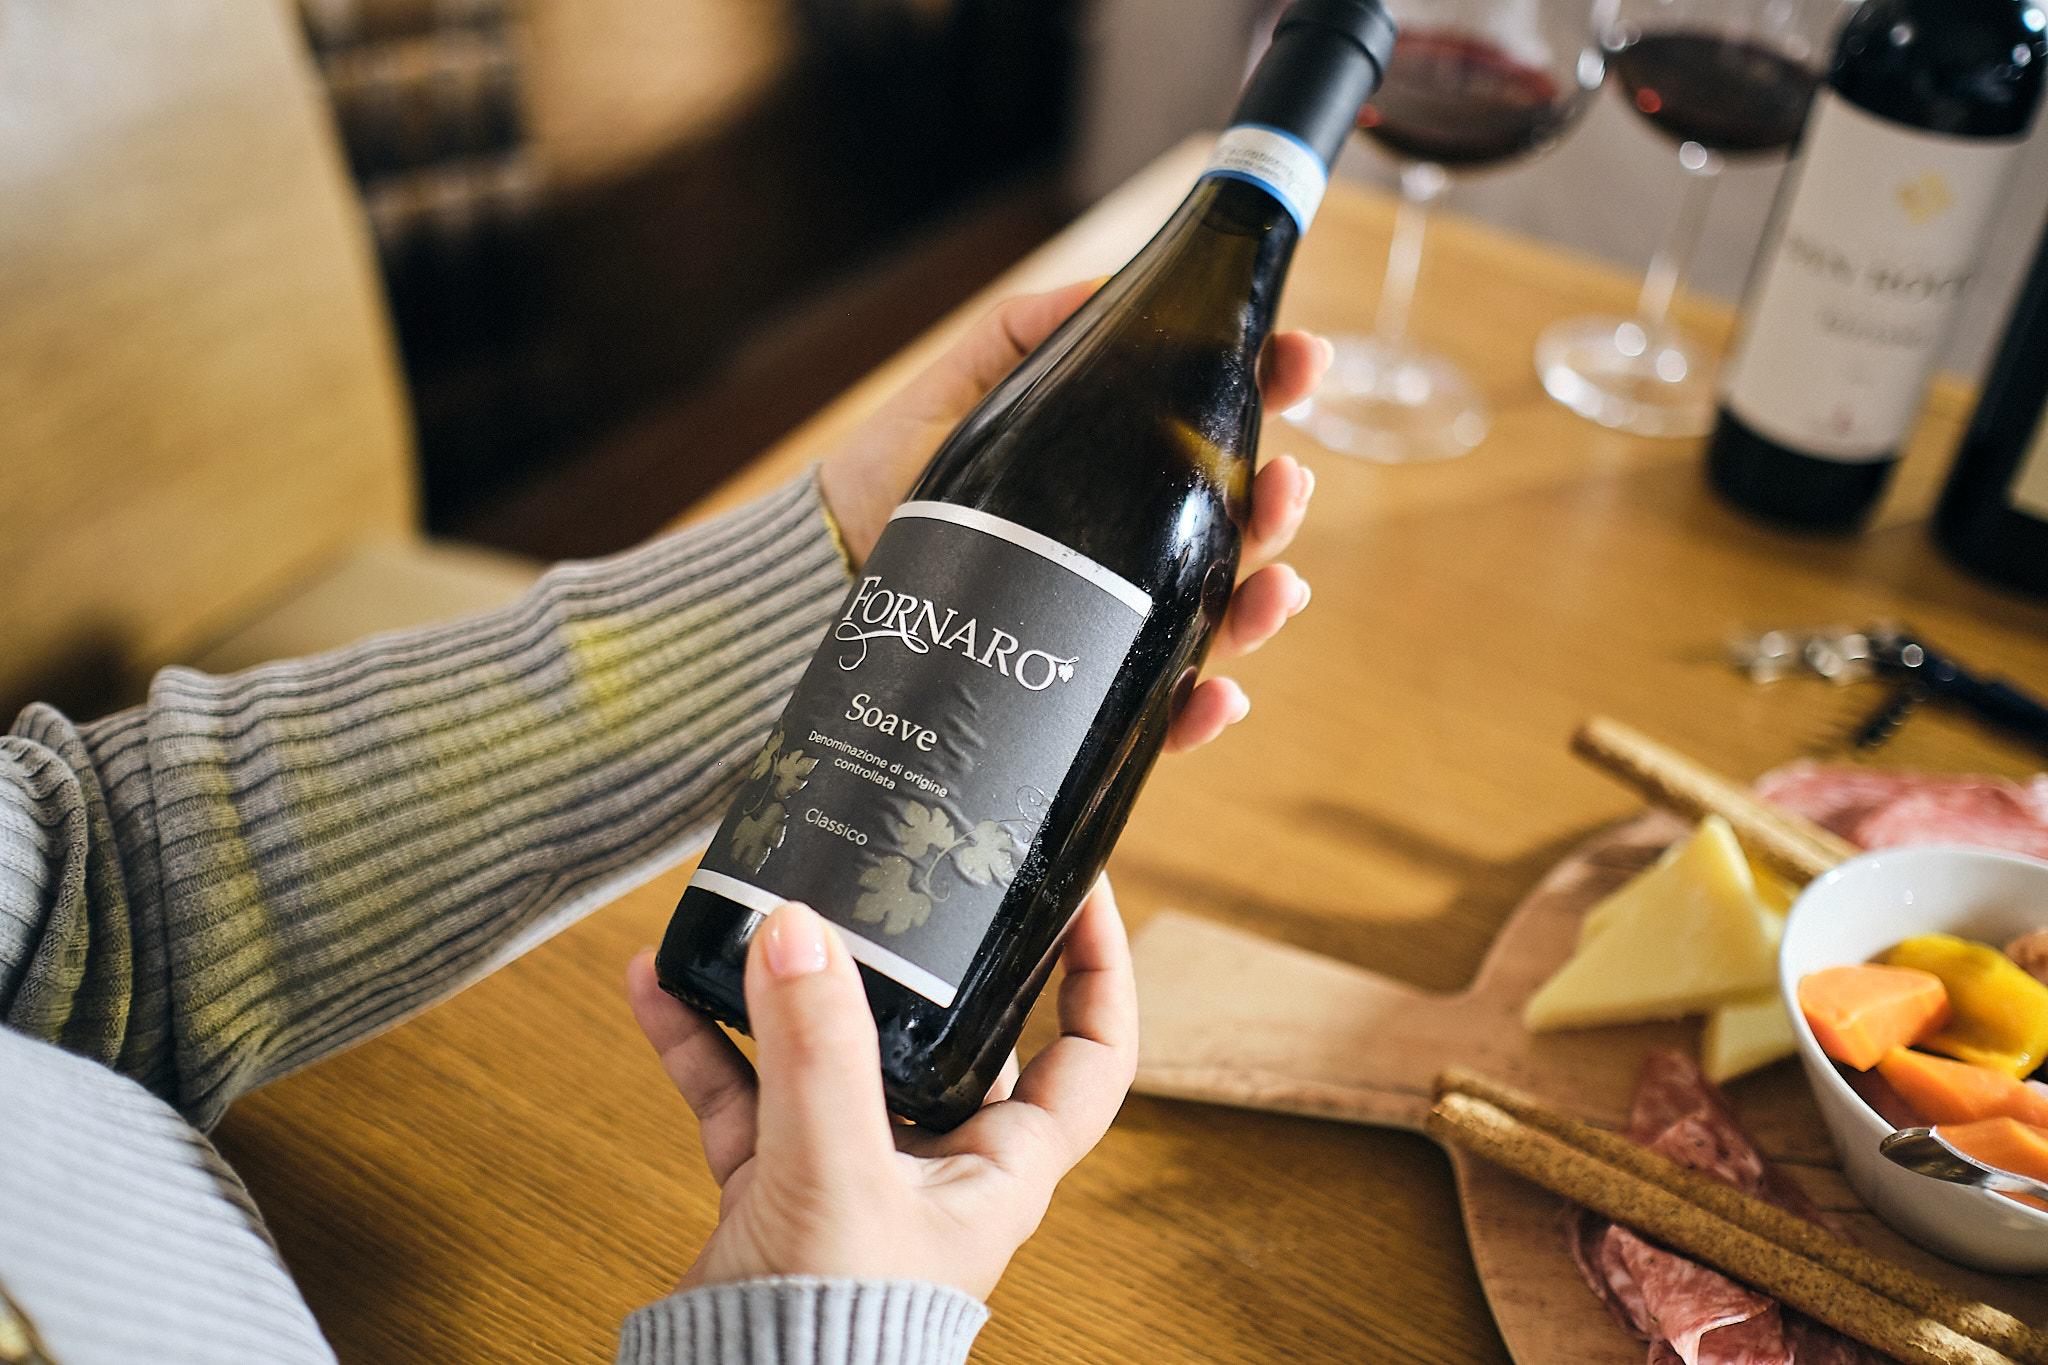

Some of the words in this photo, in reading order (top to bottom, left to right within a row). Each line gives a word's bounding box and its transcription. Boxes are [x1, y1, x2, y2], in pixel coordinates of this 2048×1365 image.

[836, 576, 1079, 691] FORNARO
[845, 693, 938, 752] Soave
[808, 730, 889, 769] Denominazione
[889, 763, 904, 775] di
[904, 771, 948, 798] origine
[834, 757, 896, 790] controllata
[805, 808, 868, 846] Classico
